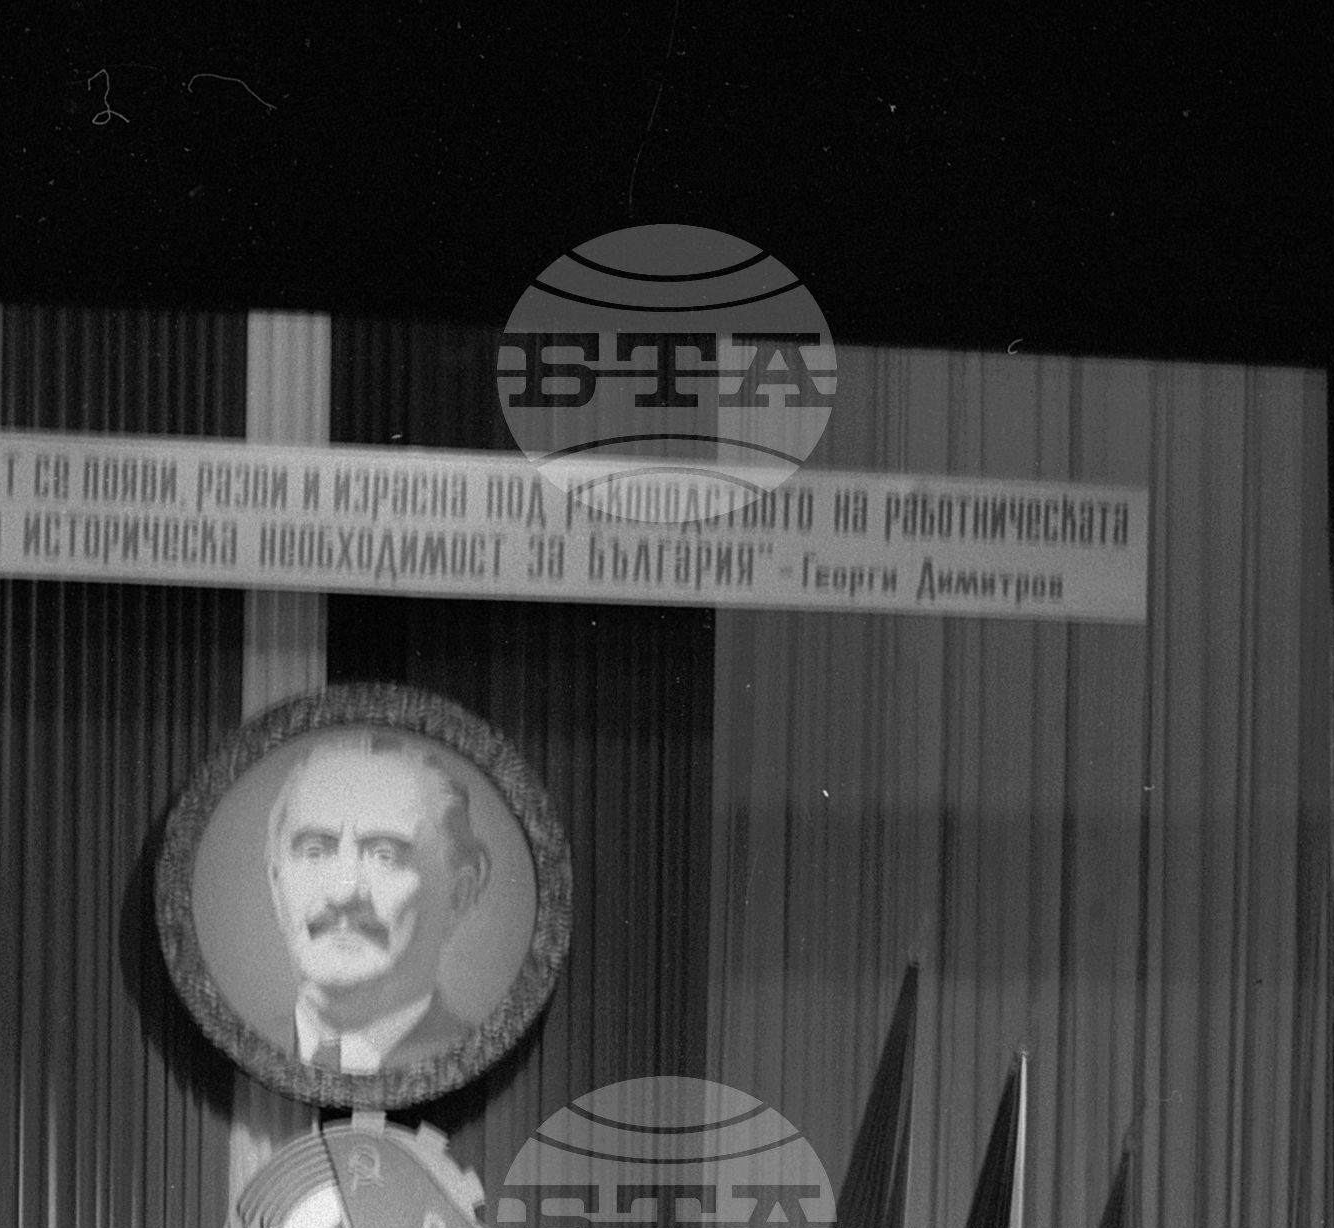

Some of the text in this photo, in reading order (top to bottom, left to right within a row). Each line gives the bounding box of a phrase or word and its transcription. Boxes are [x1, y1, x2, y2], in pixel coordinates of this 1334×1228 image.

[34, 453, 70, 501] се
[303, 467, 321, 512] и
[334, 467, 468, 523] израсна
[485, 473, 547, 530] под
[833, 487, 868, 537] на
[884, 488, 1130, 549] работническата
[22, 509, 239, 568] историческа
[258, 522, 509, 586] необходимост
[527, 534, 565, 583] за
[802, 551, 898, 598] Георги
[915, 554, 1064, 608] Димитров
